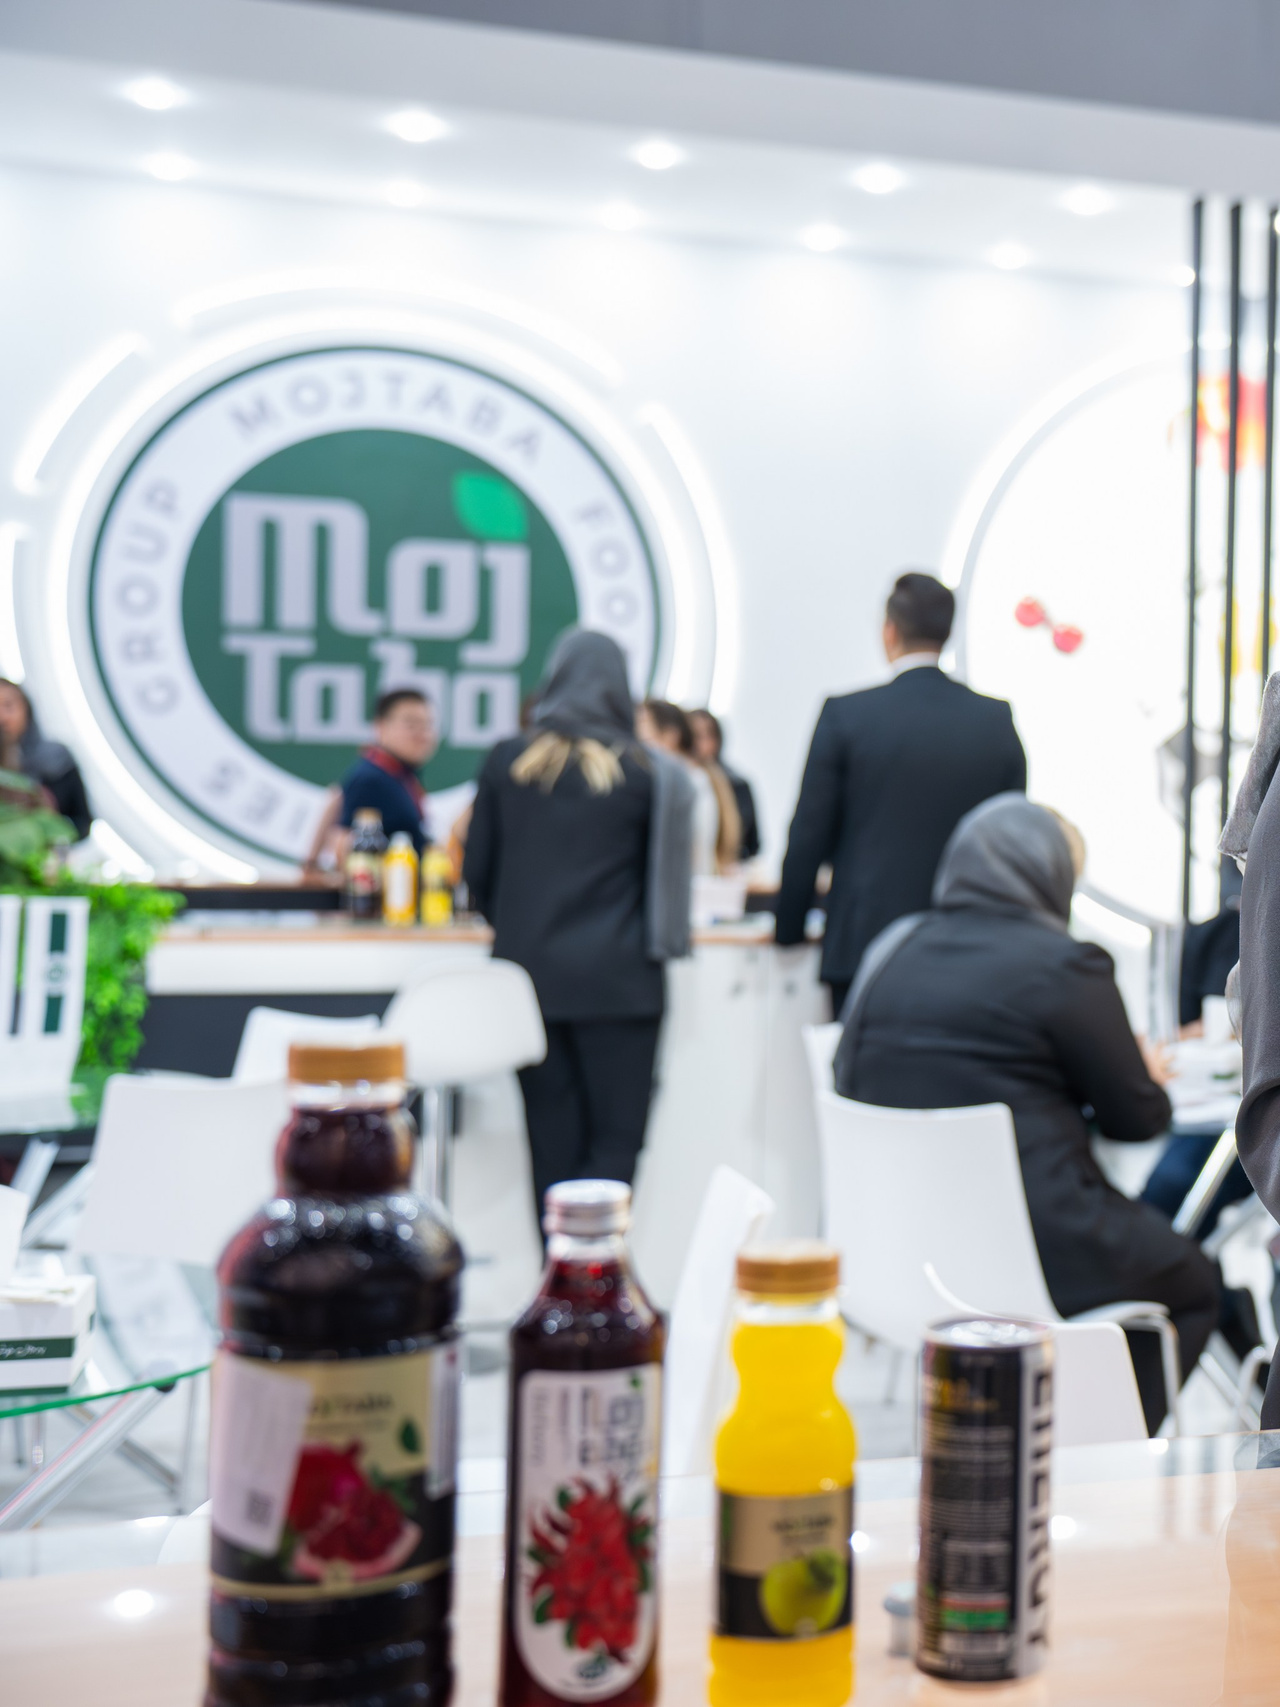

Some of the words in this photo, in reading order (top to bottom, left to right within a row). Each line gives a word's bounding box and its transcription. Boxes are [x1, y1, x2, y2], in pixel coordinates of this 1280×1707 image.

[233, 368, 542, 463] MOJTABA
[117, 476, 180, 715] GROUP
[222, 491, 532, 668] Moj
[573, 500, 641, 630] FOO
